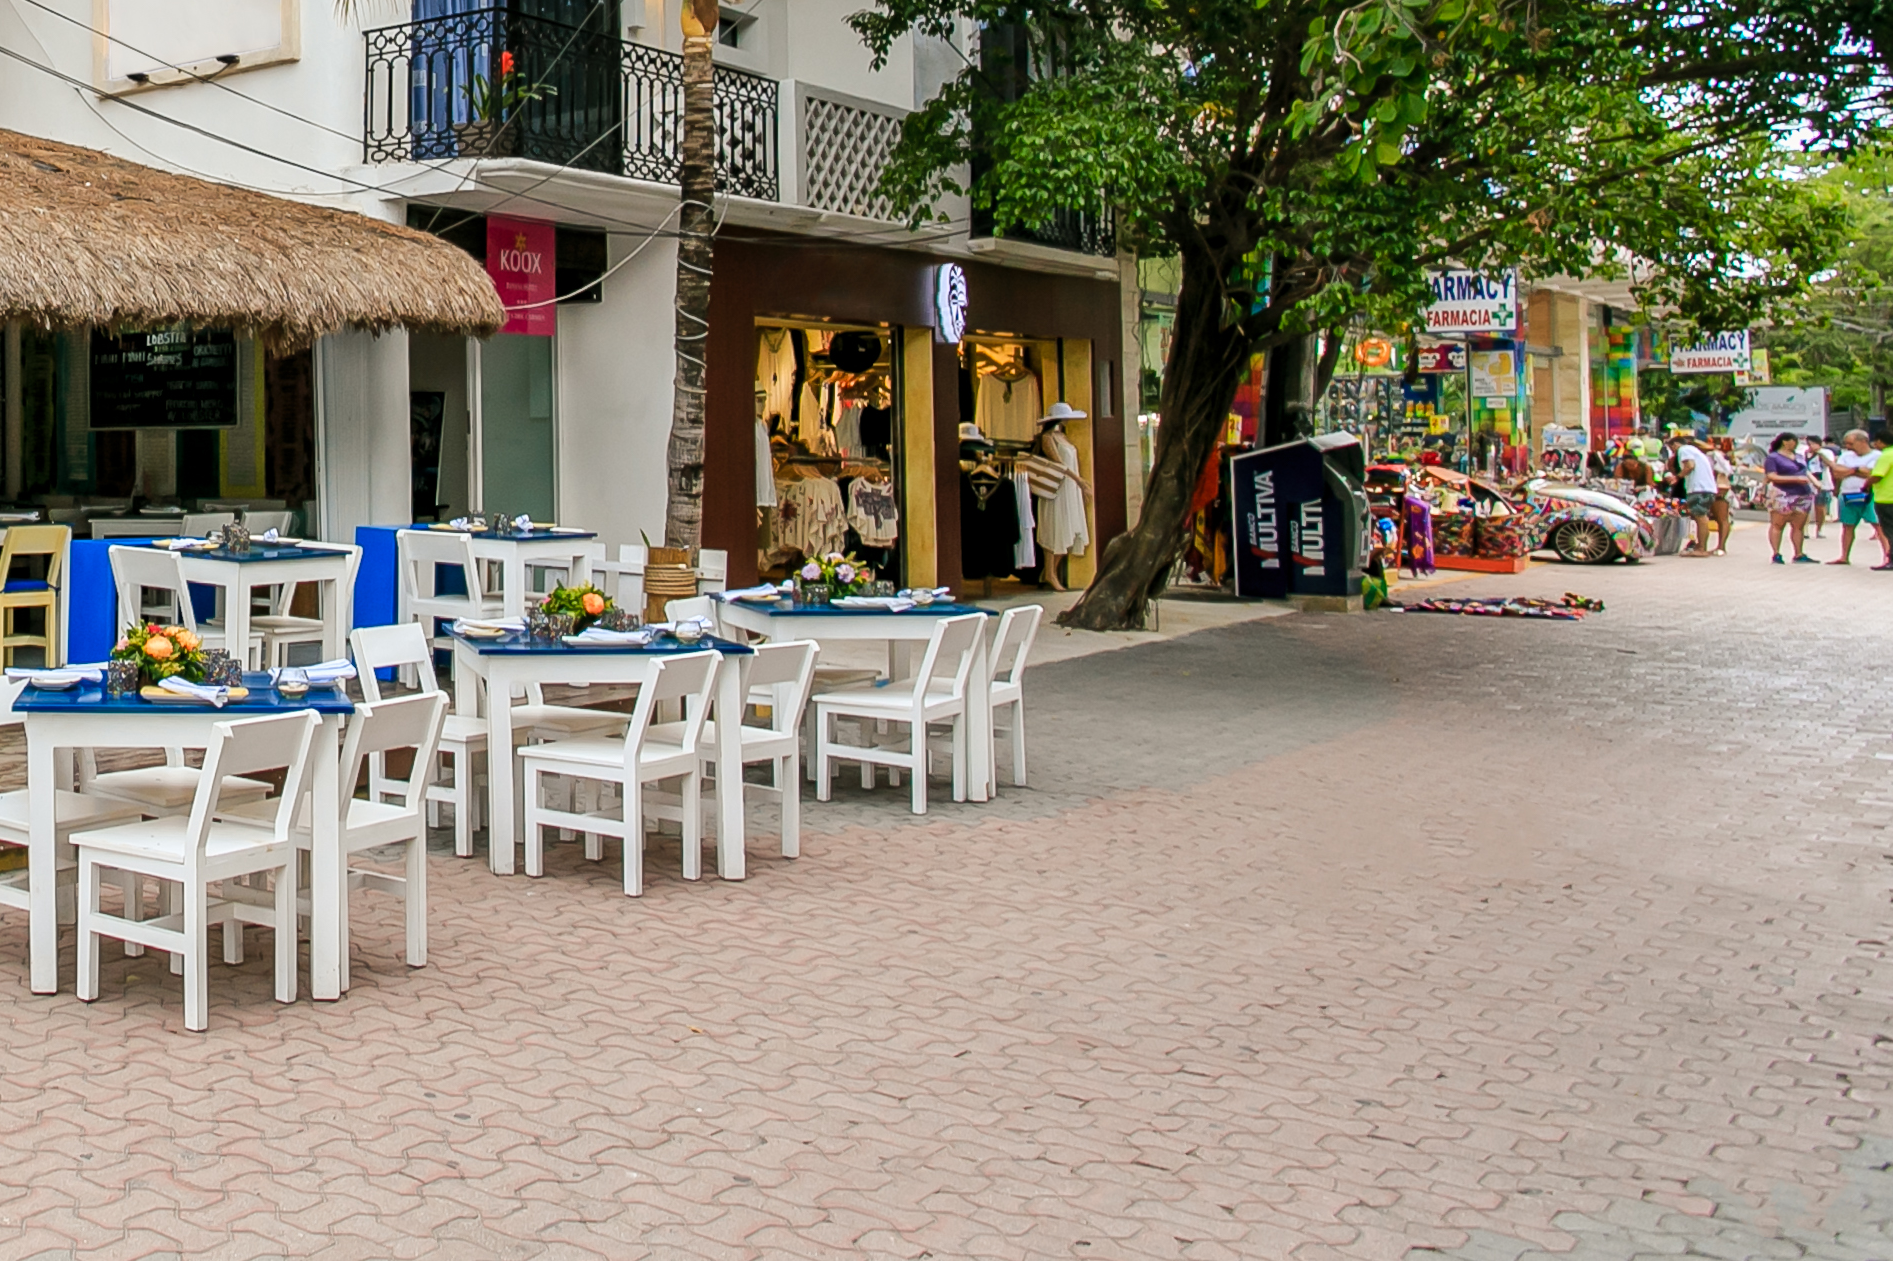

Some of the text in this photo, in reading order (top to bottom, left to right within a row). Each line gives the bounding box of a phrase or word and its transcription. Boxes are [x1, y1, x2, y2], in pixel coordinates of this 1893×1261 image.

[500, 249, 542, 275] KOOX
[1431, 274, 1512, 301] ARMACY
[1426, 308, 1491, 327] FARMACIA
[1687, 356, 1733, 369] FARMACIA
[1248, 512, 1257, 545] BANCO
[1254, 470, 1280, 568] MULTIVA
